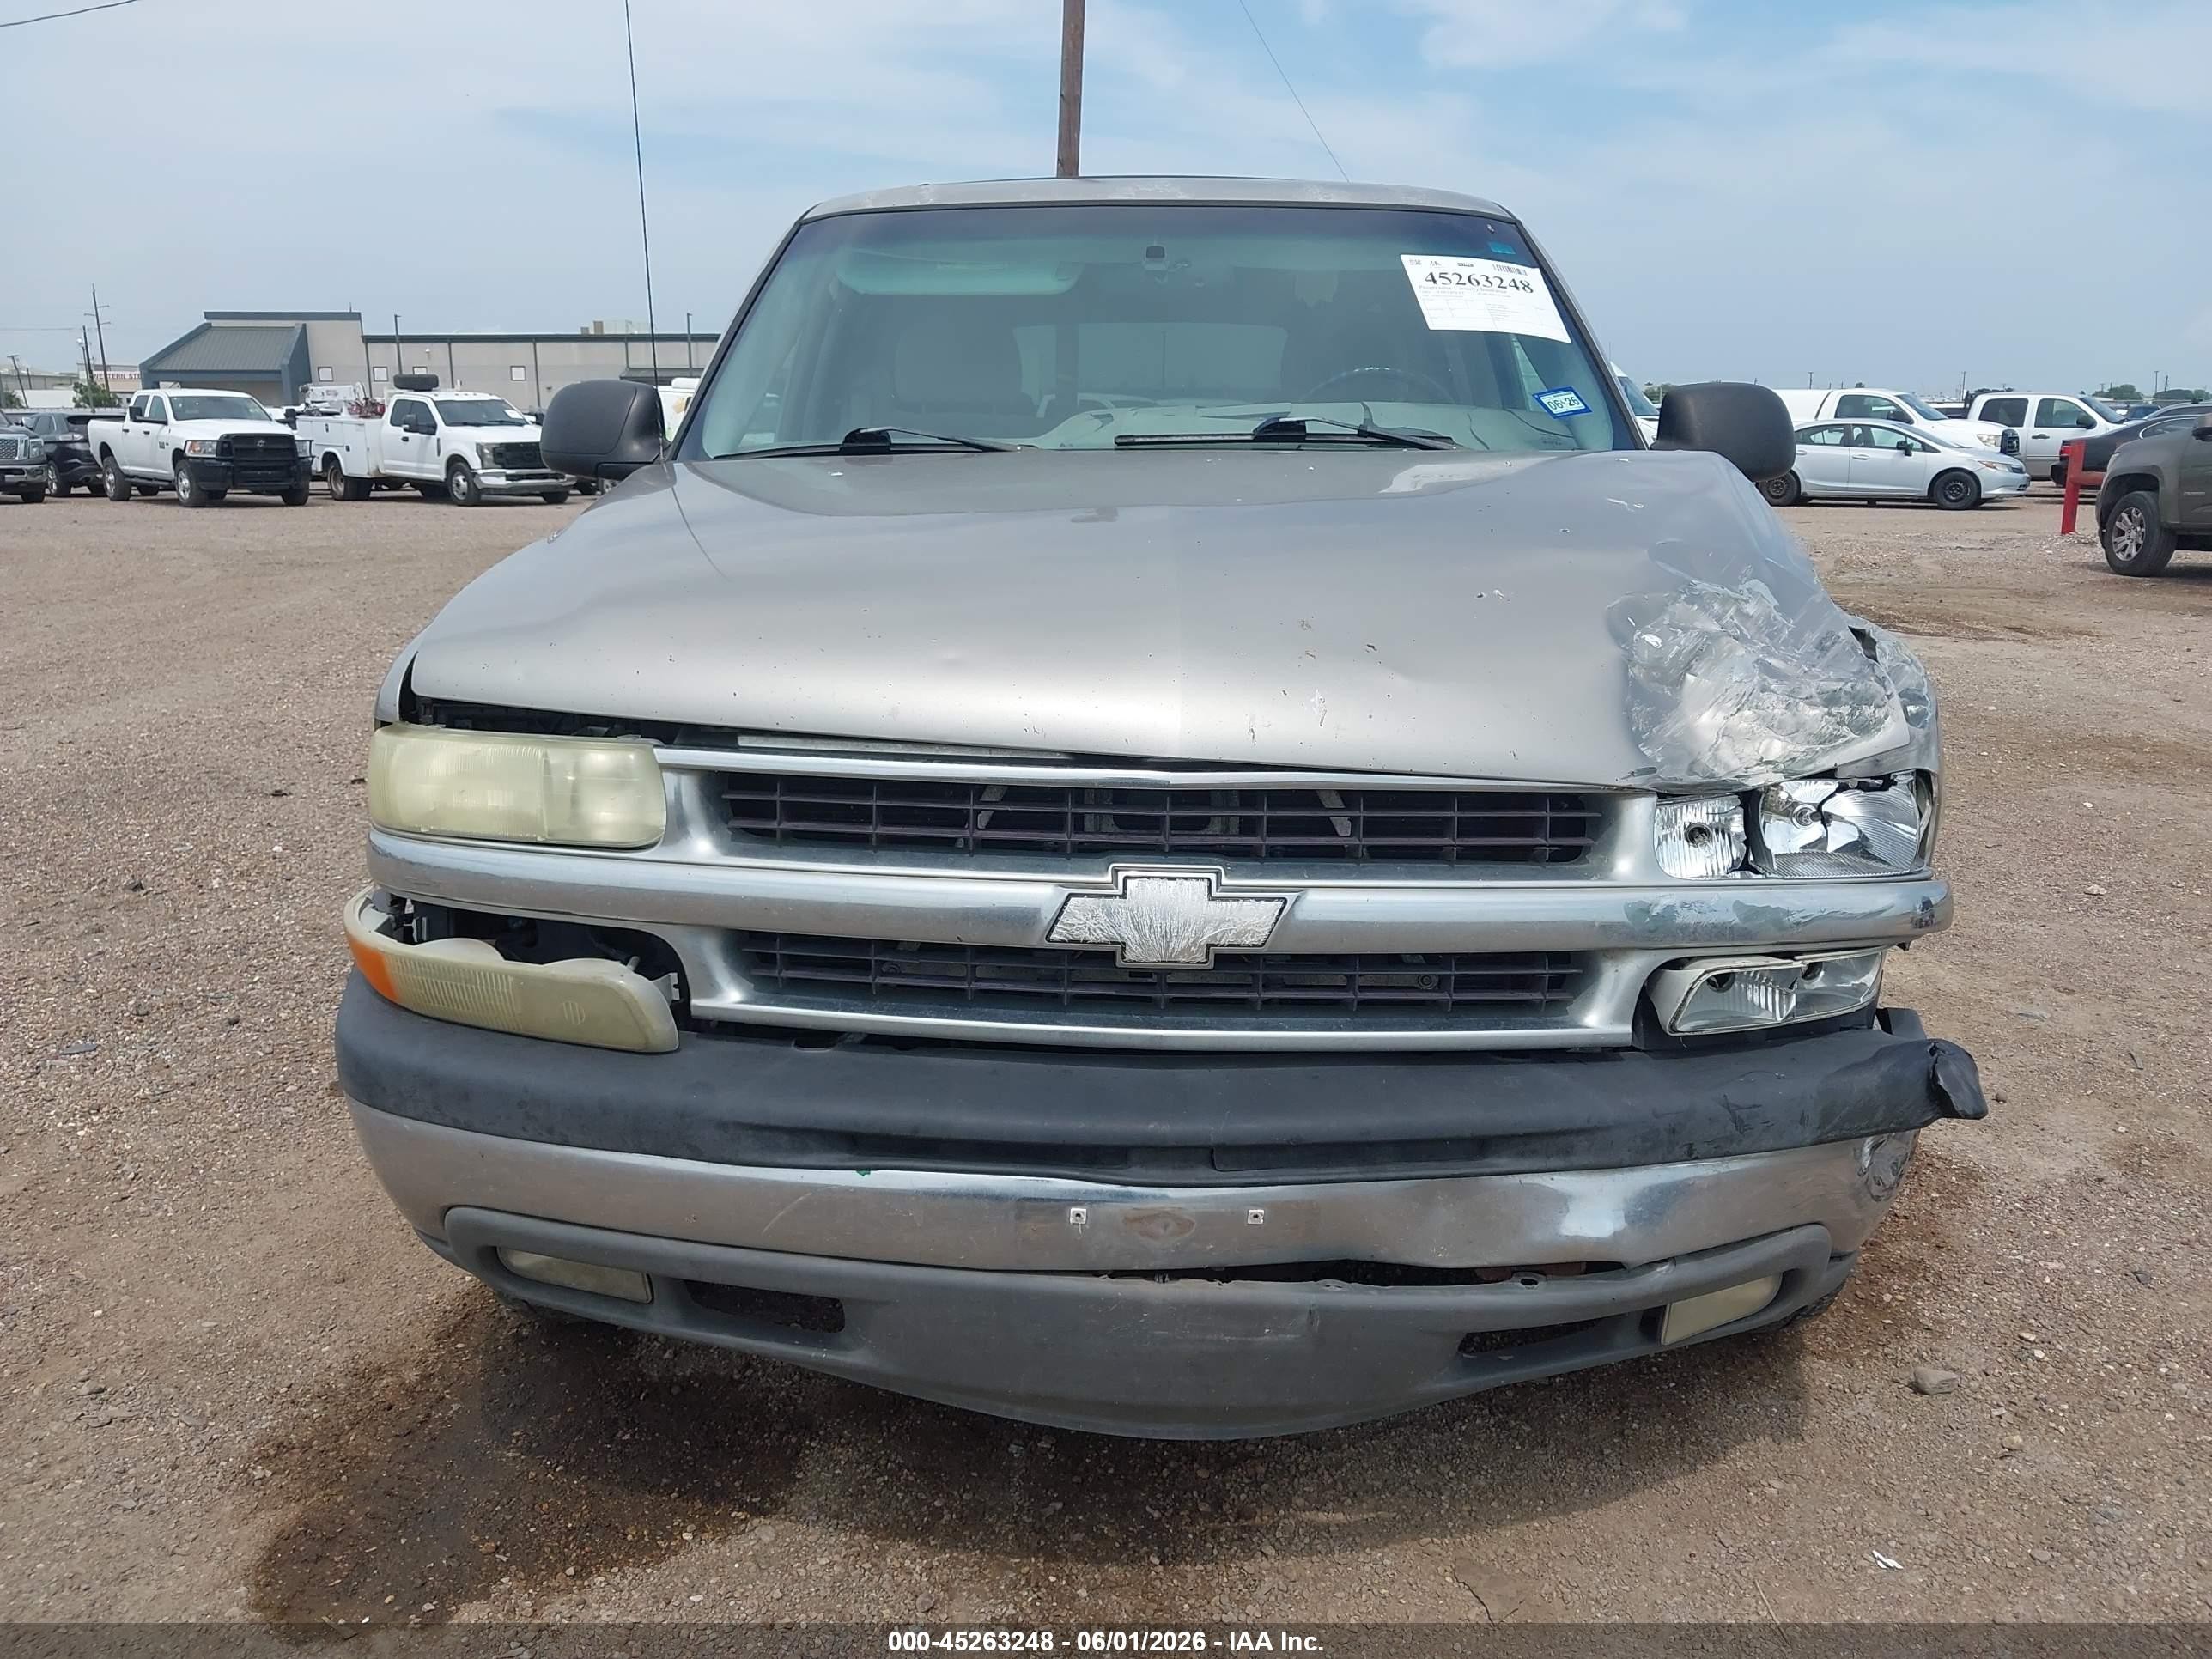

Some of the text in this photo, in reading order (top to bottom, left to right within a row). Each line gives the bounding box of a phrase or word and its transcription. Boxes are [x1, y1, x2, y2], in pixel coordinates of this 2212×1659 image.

[1425, 271, 1534, 294] 45263248
[1547, 396, 1580, 410] 06 26
